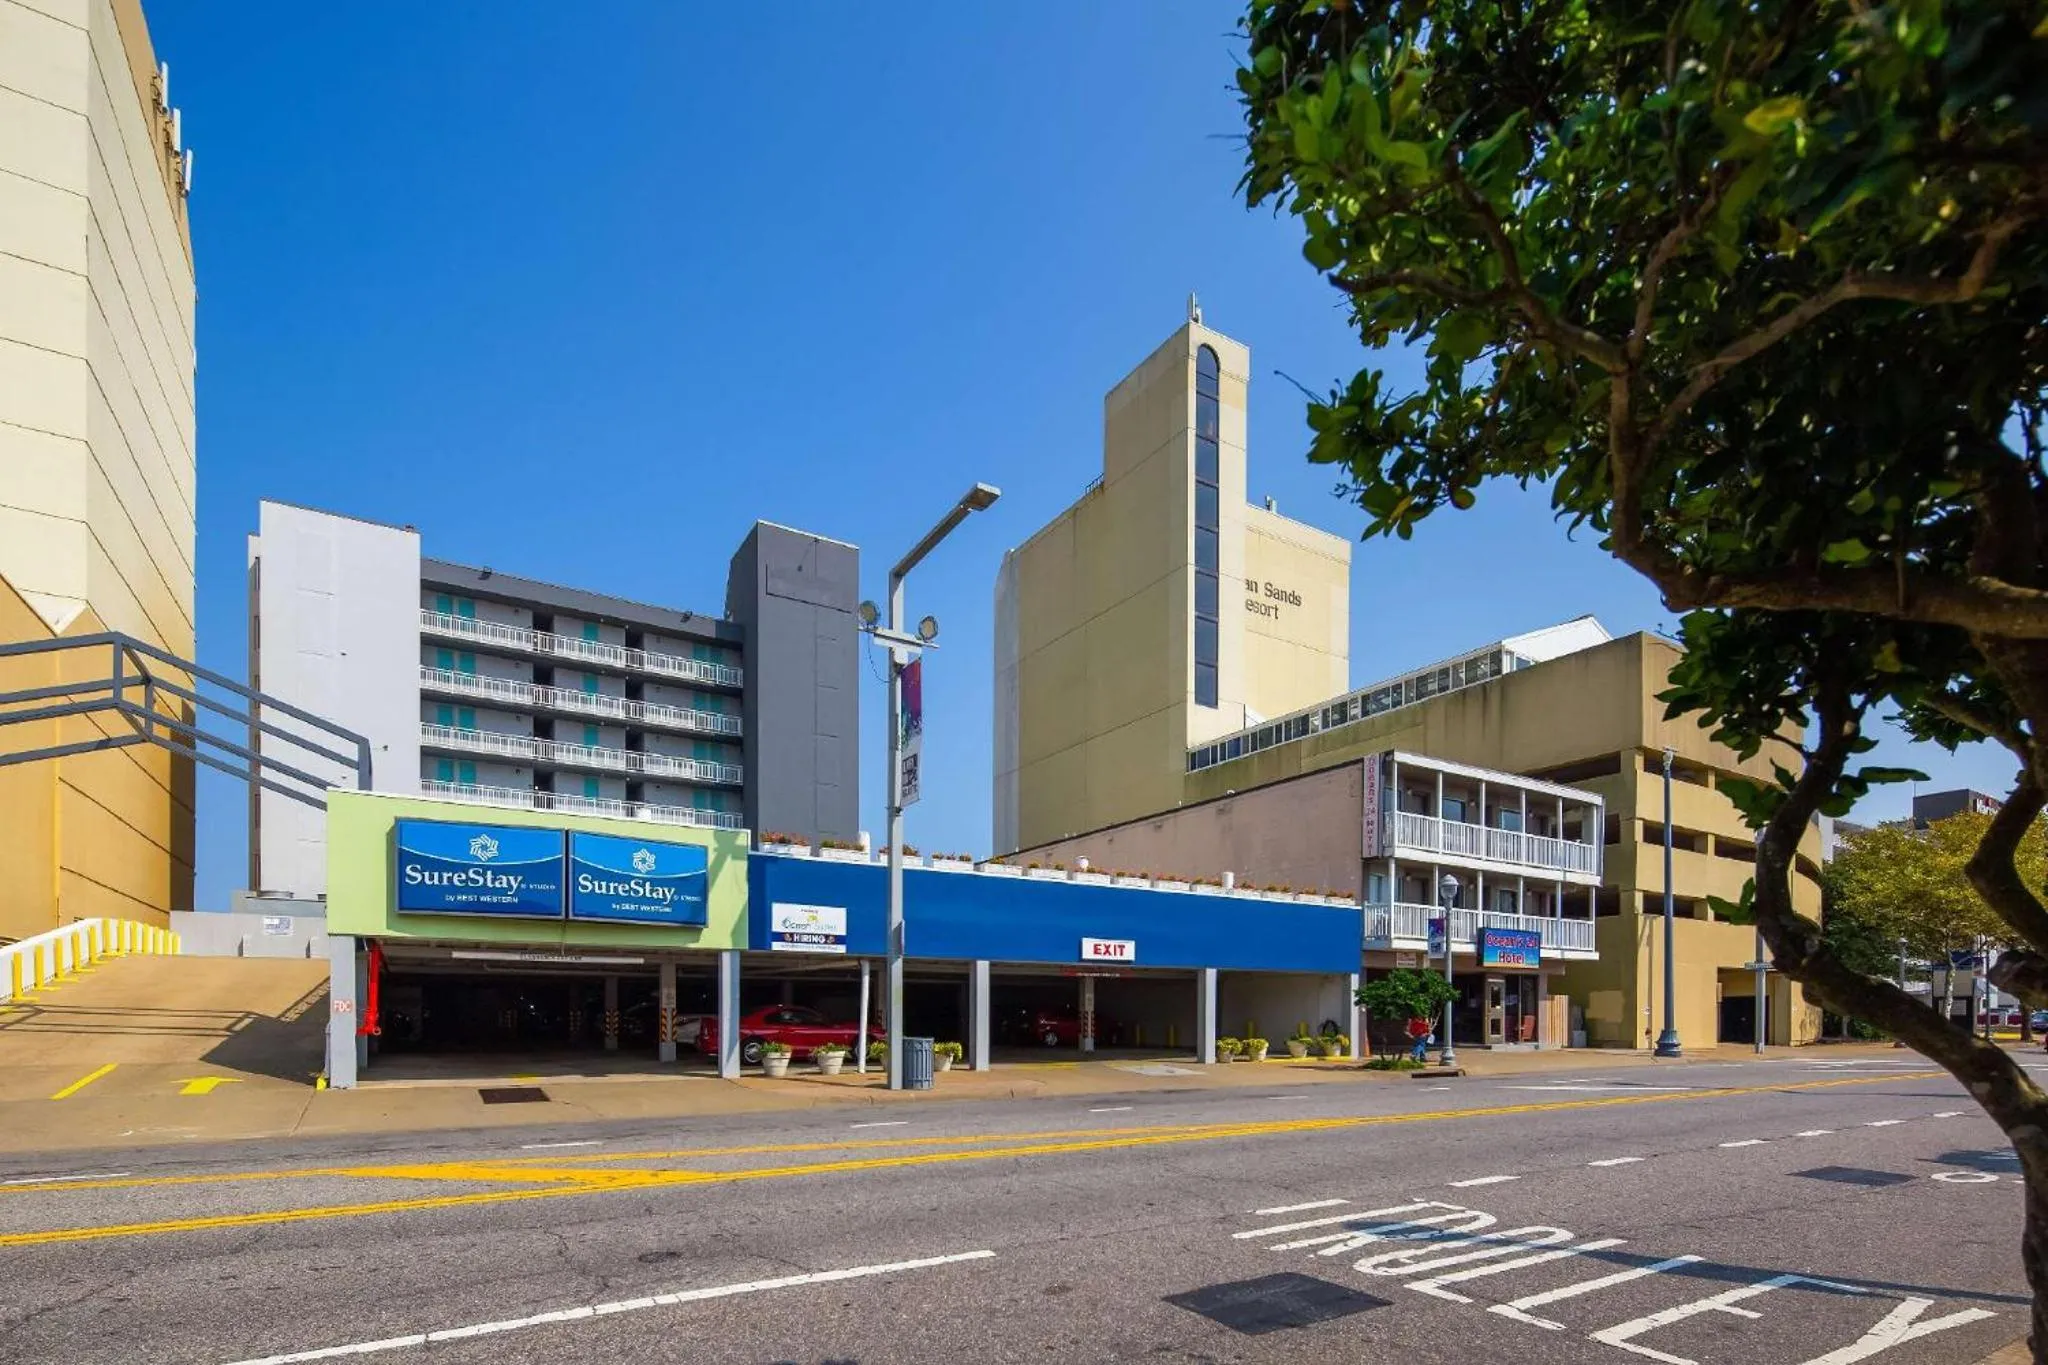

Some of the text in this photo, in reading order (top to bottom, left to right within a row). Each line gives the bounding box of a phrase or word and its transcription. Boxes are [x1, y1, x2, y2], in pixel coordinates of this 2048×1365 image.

[1264, 582, 1302, 607] Sands
[404, 864, 523, 894] SureStay
[578, 873, 675, 904] SureStay
[445, 894, 519, 904] by BEST WESTERN
[621, 902, 639, 910] BEST
[793, 933, 826, 944] HIRING
[1093, 943, 1126, 957] EXIT
[1499, 950, 1526, 964] Hotel
